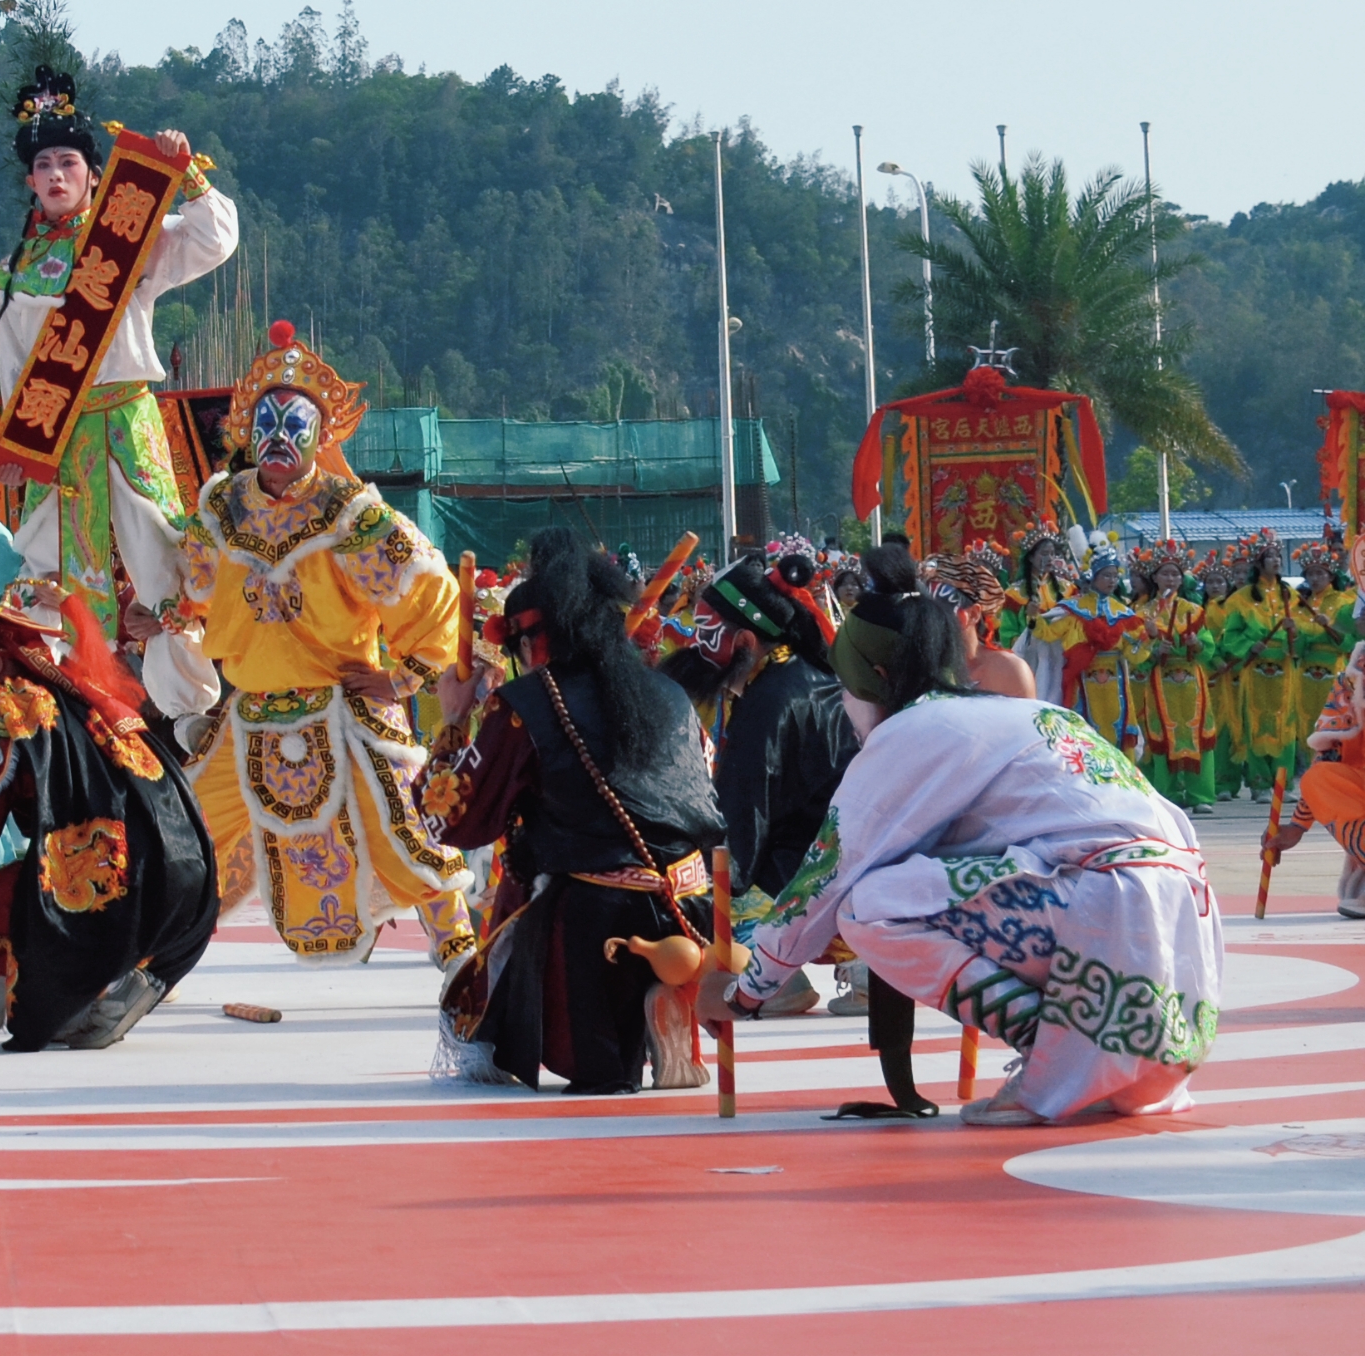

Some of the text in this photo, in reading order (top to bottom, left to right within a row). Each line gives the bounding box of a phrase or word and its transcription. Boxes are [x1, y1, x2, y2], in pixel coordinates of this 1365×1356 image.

[15, 181, 157, 439] 潮起汕頭
[968, 500, 998, 541] 西
